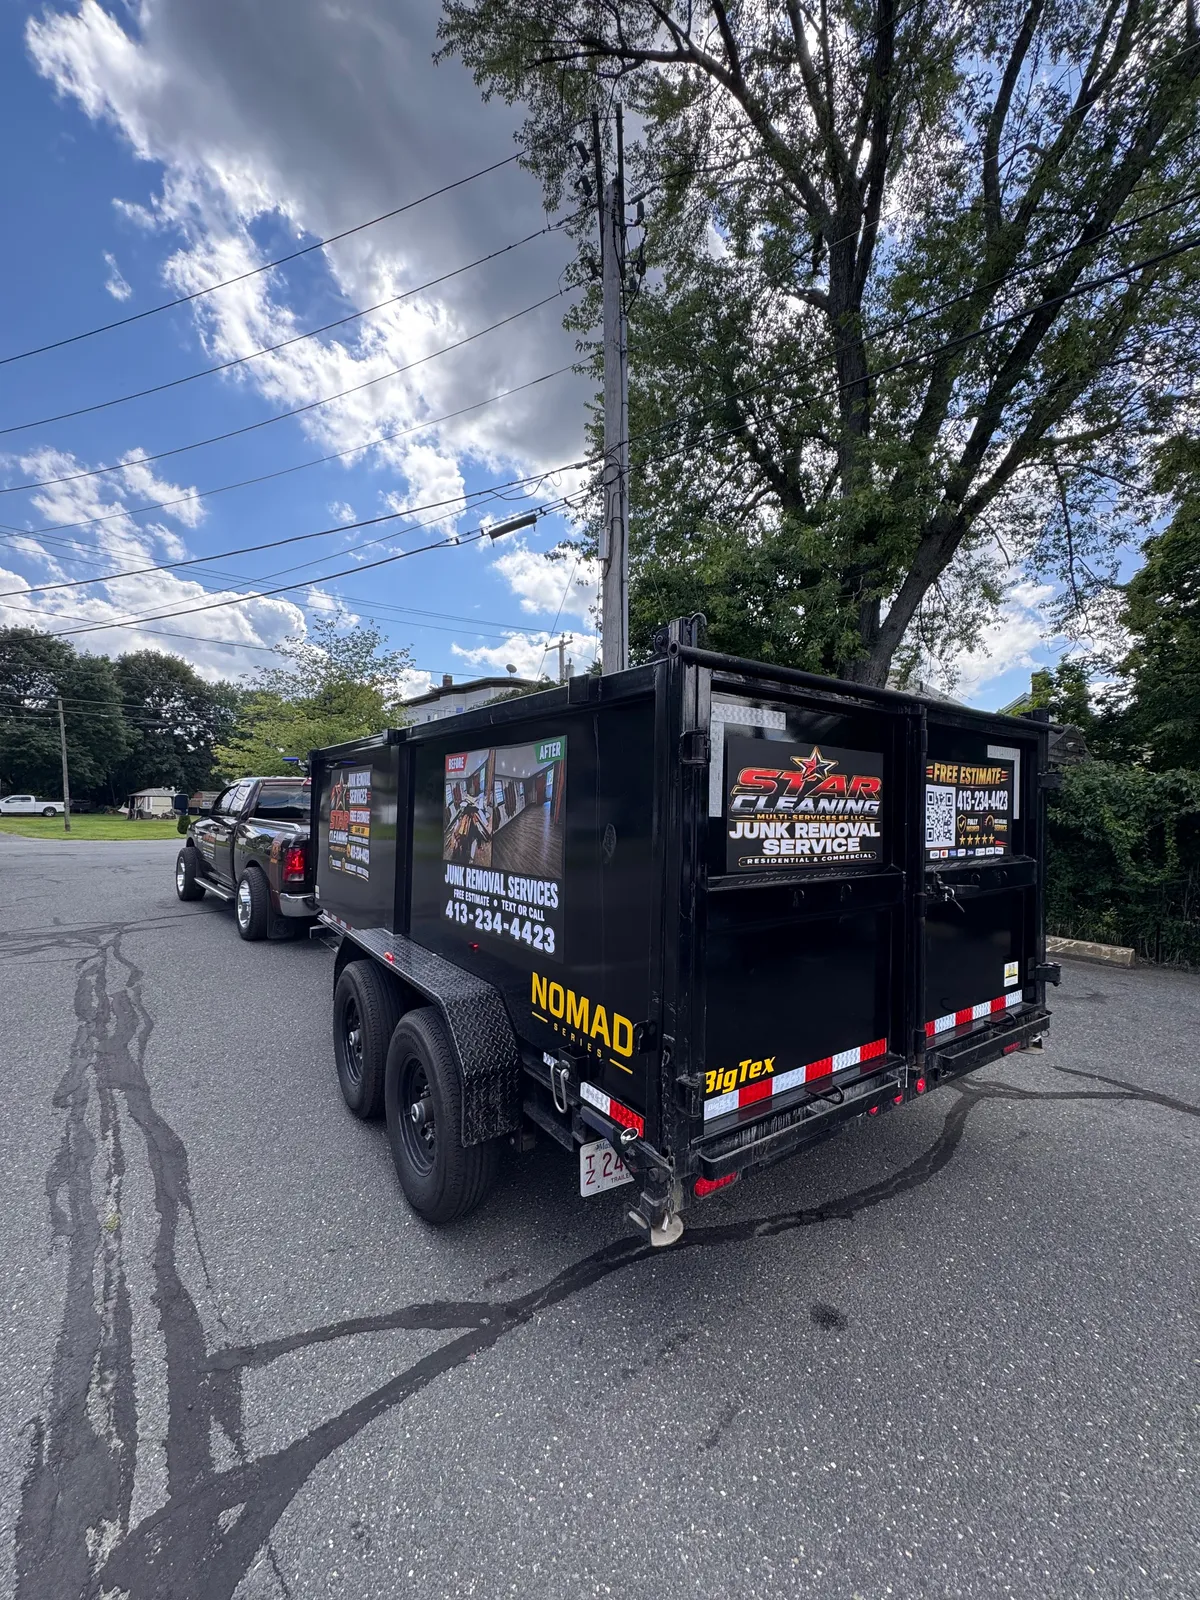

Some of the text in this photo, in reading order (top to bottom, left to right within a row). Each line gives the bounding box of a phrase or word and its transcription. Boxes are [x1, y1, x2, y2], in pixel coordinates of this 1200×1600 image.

[539, 742, 561, 760] AFTER
[448, 756, 465, 770] BEFORE
[730, 767, 882, 800] STAR
[934, 762, 1001, 785] FREE ESTIMATE
[730, 795, 881, 815] CLEANING
[957, 790, 1008, 811] 413-234-4423
[330, 810, 349, 830] STAR
[756, 813, 836, 821] MULTI-SERVICES
[729, 822, 880, 839] JUNK REMOVAL
[762, 837, 860, 855] SERVICE
[821, 853, 872, 861] COMMERCIAL
[445, 864, 558, 909] JUNK REMOVAL SERVICES
[453, 889, 545, 921] FREE ESTIMATE TEXT OR CALL
[445, 900, 555, 954] 413-234-4423
[531, 971, 633, 1058] NOMAD
[553, 1022, 602, 1058] SERIES
[611, 1172, 634, 1184] TRAILE
